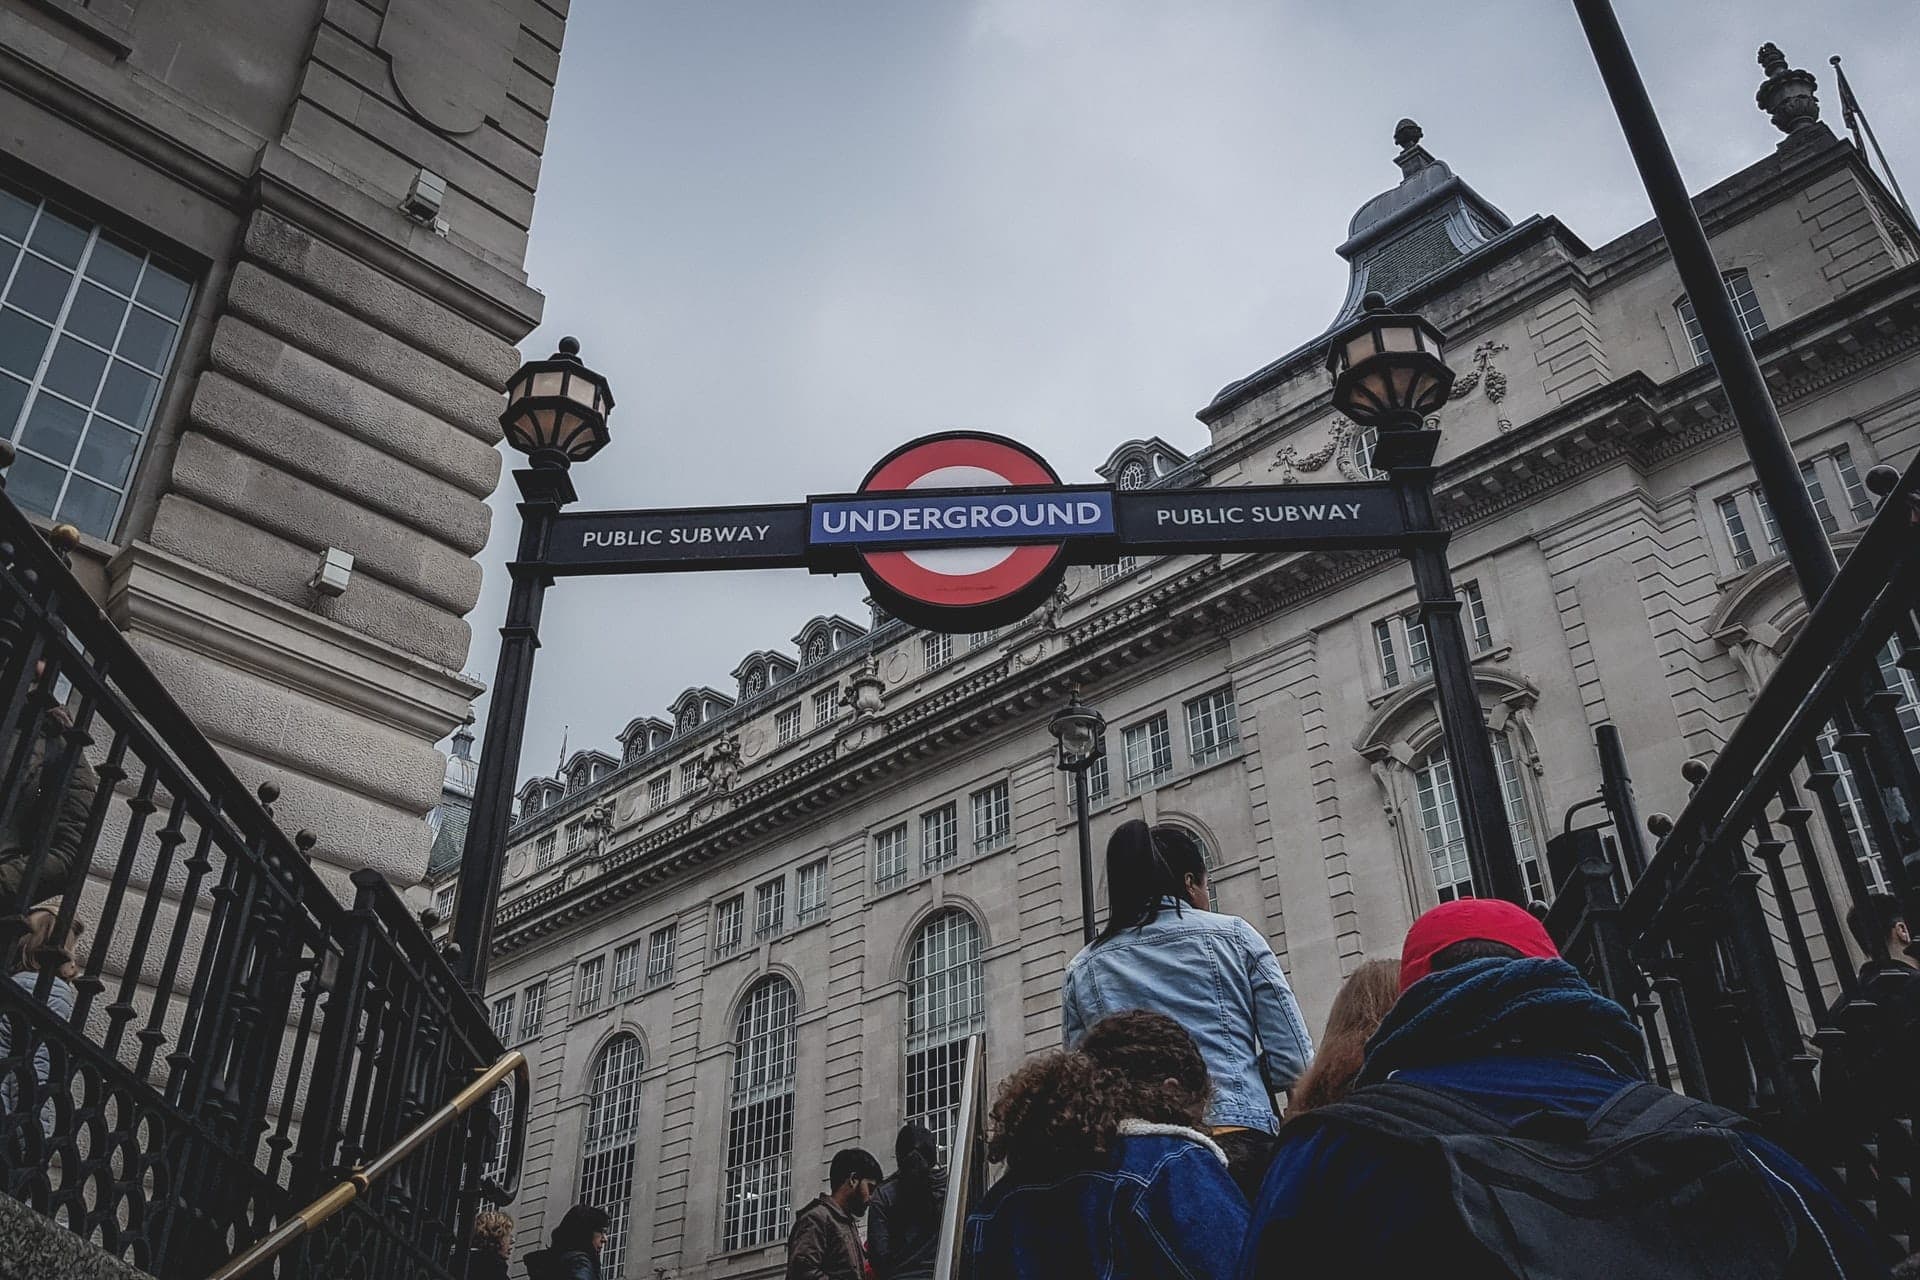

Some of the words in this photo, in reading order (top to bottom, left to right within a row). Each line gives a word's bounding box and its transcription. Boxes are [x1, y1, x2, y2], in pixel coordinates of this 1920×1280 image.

[822, 502, 1101, 534] UNDERGROUND
[1157, 507, 1245, 525] PUBLIC
[1252, 503, 1361, 522] SUBWAY
[582, 529, 663, 547] PUBLIC
[669, 525, 770, 545] SUBWAY
